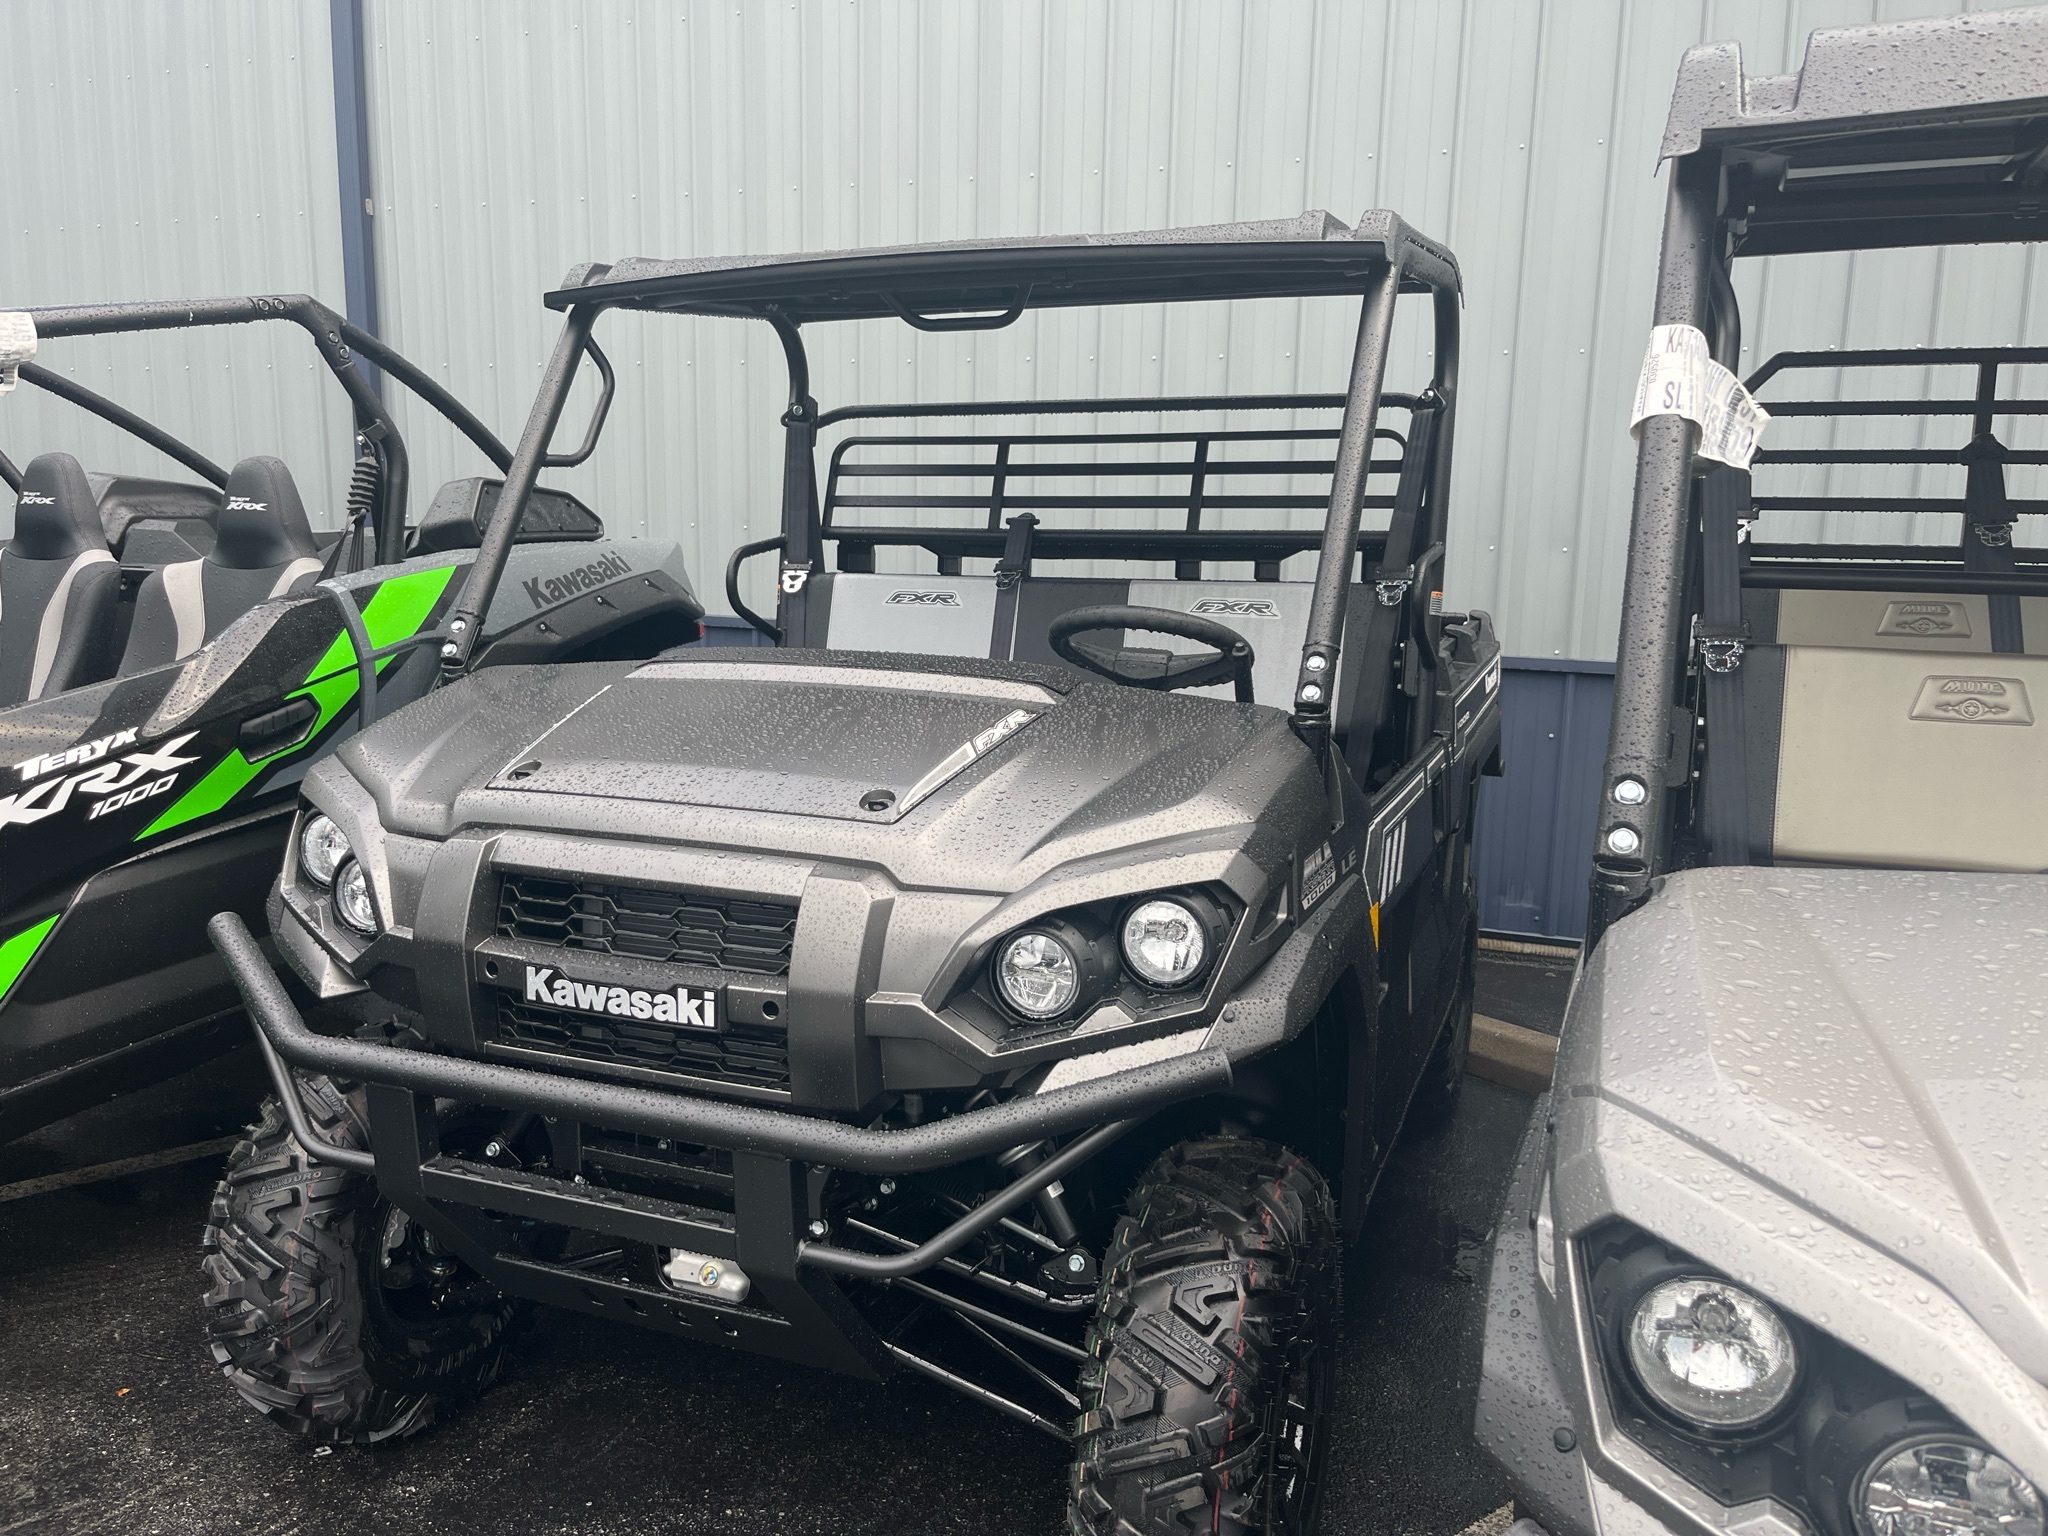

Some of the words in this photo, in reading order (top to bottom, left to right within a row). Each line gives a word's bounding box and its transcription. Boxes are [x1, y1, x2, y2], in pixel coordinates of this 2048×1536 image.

[521, 550, 633, 610] Kawasaki
[886, 590, 961, 607] FXR
[1189, 599, 1279, 617] FXR
[0, 730, 202, 831] KRX
[89, 772, 180, 821] 1000
[1341, 848, 1358, 876] LE
[1306, 875, 1334, 906] 1000
[525, 965, 715, 1028] Kawasaki
[284, 1169, 322, 1186] DURO
[1181, 1331, 1223, 1367] DURO
